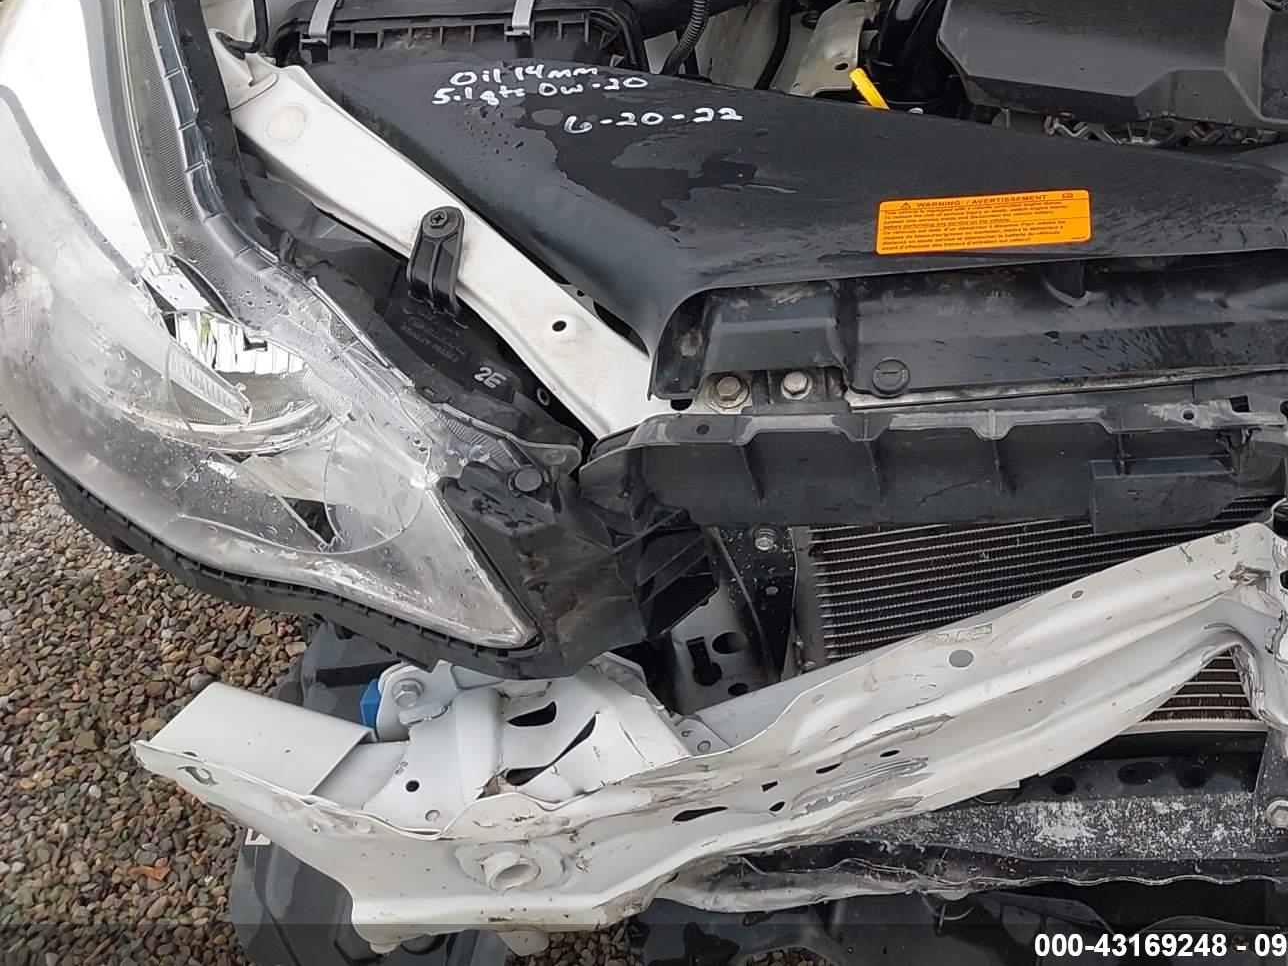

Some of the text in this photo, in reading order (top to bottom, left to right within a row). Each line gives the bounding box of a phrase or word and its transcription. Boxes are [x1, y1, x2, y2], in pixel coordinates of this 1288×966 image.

[450, 69, 500, 85] Oil
[563, 107, 744, 134] 6-20-22
[474, 367, 507, 389] 2E
